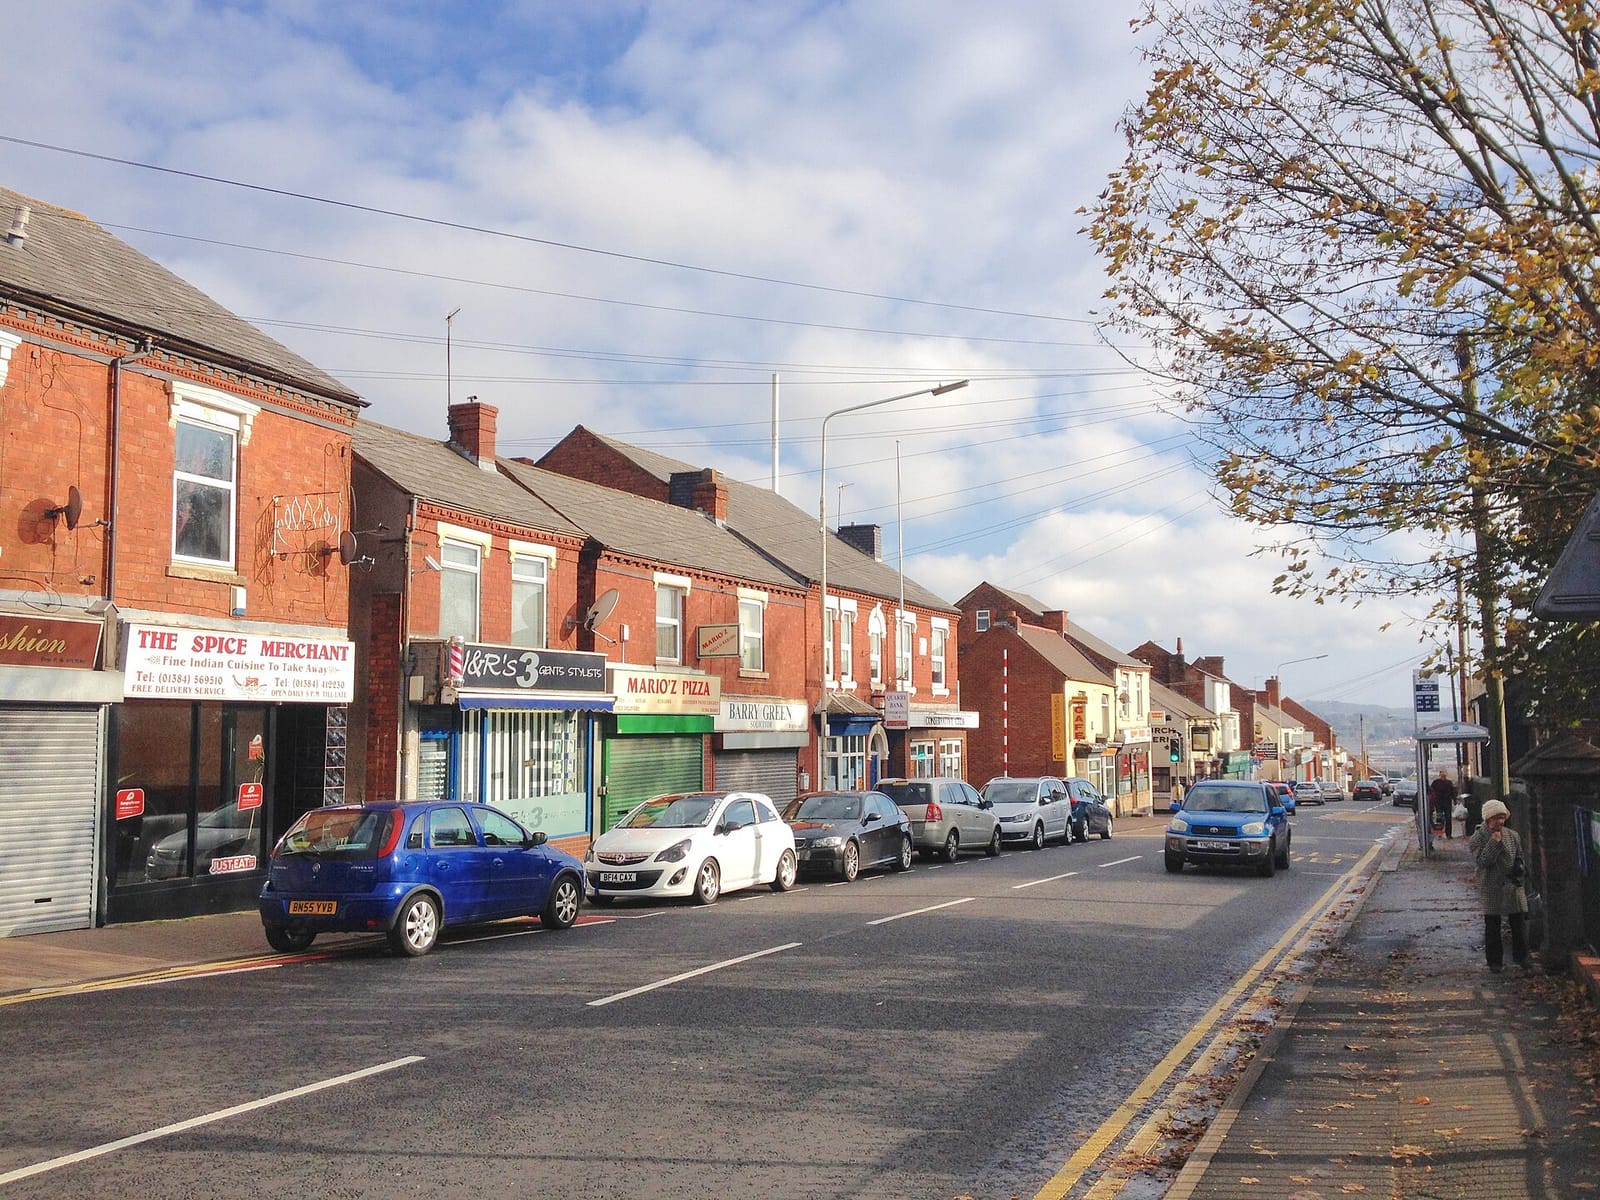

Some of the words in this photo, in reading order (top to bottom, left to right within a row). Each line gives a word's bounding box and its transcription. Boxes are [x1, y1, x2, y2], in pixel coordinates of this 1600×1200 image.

[138, 630, 178, 651] THE
[191, 635, 248, 655] SPICE
[260, 640, 349, 661] MERCHANT
[162, 655, 187, 667] Fine
[190, 657, 224, 669] Indian
[227, 659, 265, 671] Cuisine
[268, 662, 280, 671] To
[282, 662, 303, 672] Take
[306, 664, 327, 675] Away
[515, 652, 540, 688] 3
[538, 665, 565, 676] GENTS
[568, 667, 602, 678] STYLISTS
[136, 670, 155, 682] Tel:
[158, 673, 191, 685] (01384)
[627, 677, 677, 695] MARIO'Z
[682, 680, 711, 697] PIZZA
[132, 684, 153, 693] FREE
[155, 685, 193, 695] DELIVERY
[194, 687, 226, 696] SERVICE
[729, 702, 759, 721] BARRY
[762, 703, 792, 721] GREEN
[1074, 706, 1086, 740] CAFE
[211, 859, 233, 872] JUST
[233, 857, 250, 869] EAT
[603, 873, 618, 882] BF14
[619, 873, 633, 882] CAX
[292, 902, 314, 913] BN55
[316, 902, 333, 913] YVB
